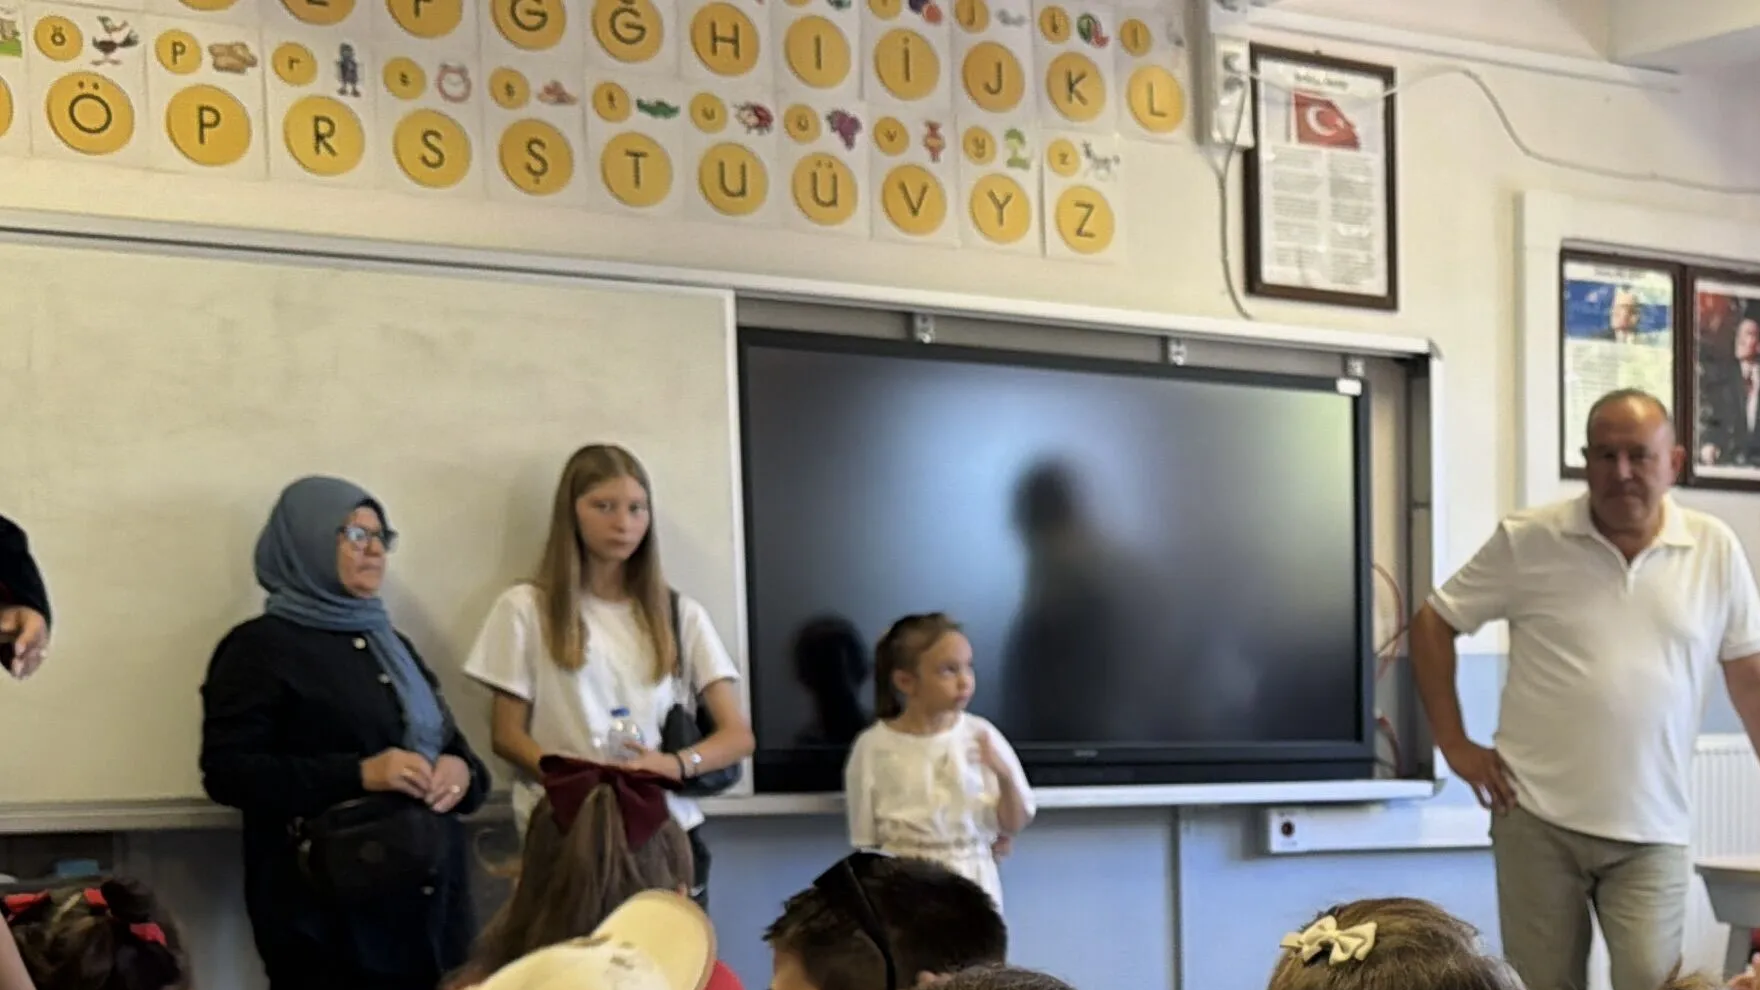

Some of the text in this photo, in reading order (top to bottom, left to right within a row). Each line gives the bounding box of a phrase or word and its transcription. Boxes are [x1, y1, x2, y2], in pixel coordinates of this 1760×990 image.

[50, 25, 66, 47] ö
[287, 55, 301, 71] r
[510, 0, 548, 32] G
[708, 20, 740, 60] H
[983, 61, 1003, 95] J
[1065, 69, 1088, 106] K
[1147, 80, 1168, 118] L
[68, 79, 1098, 239] Ö P R S Ş T U Ü V Y Z
